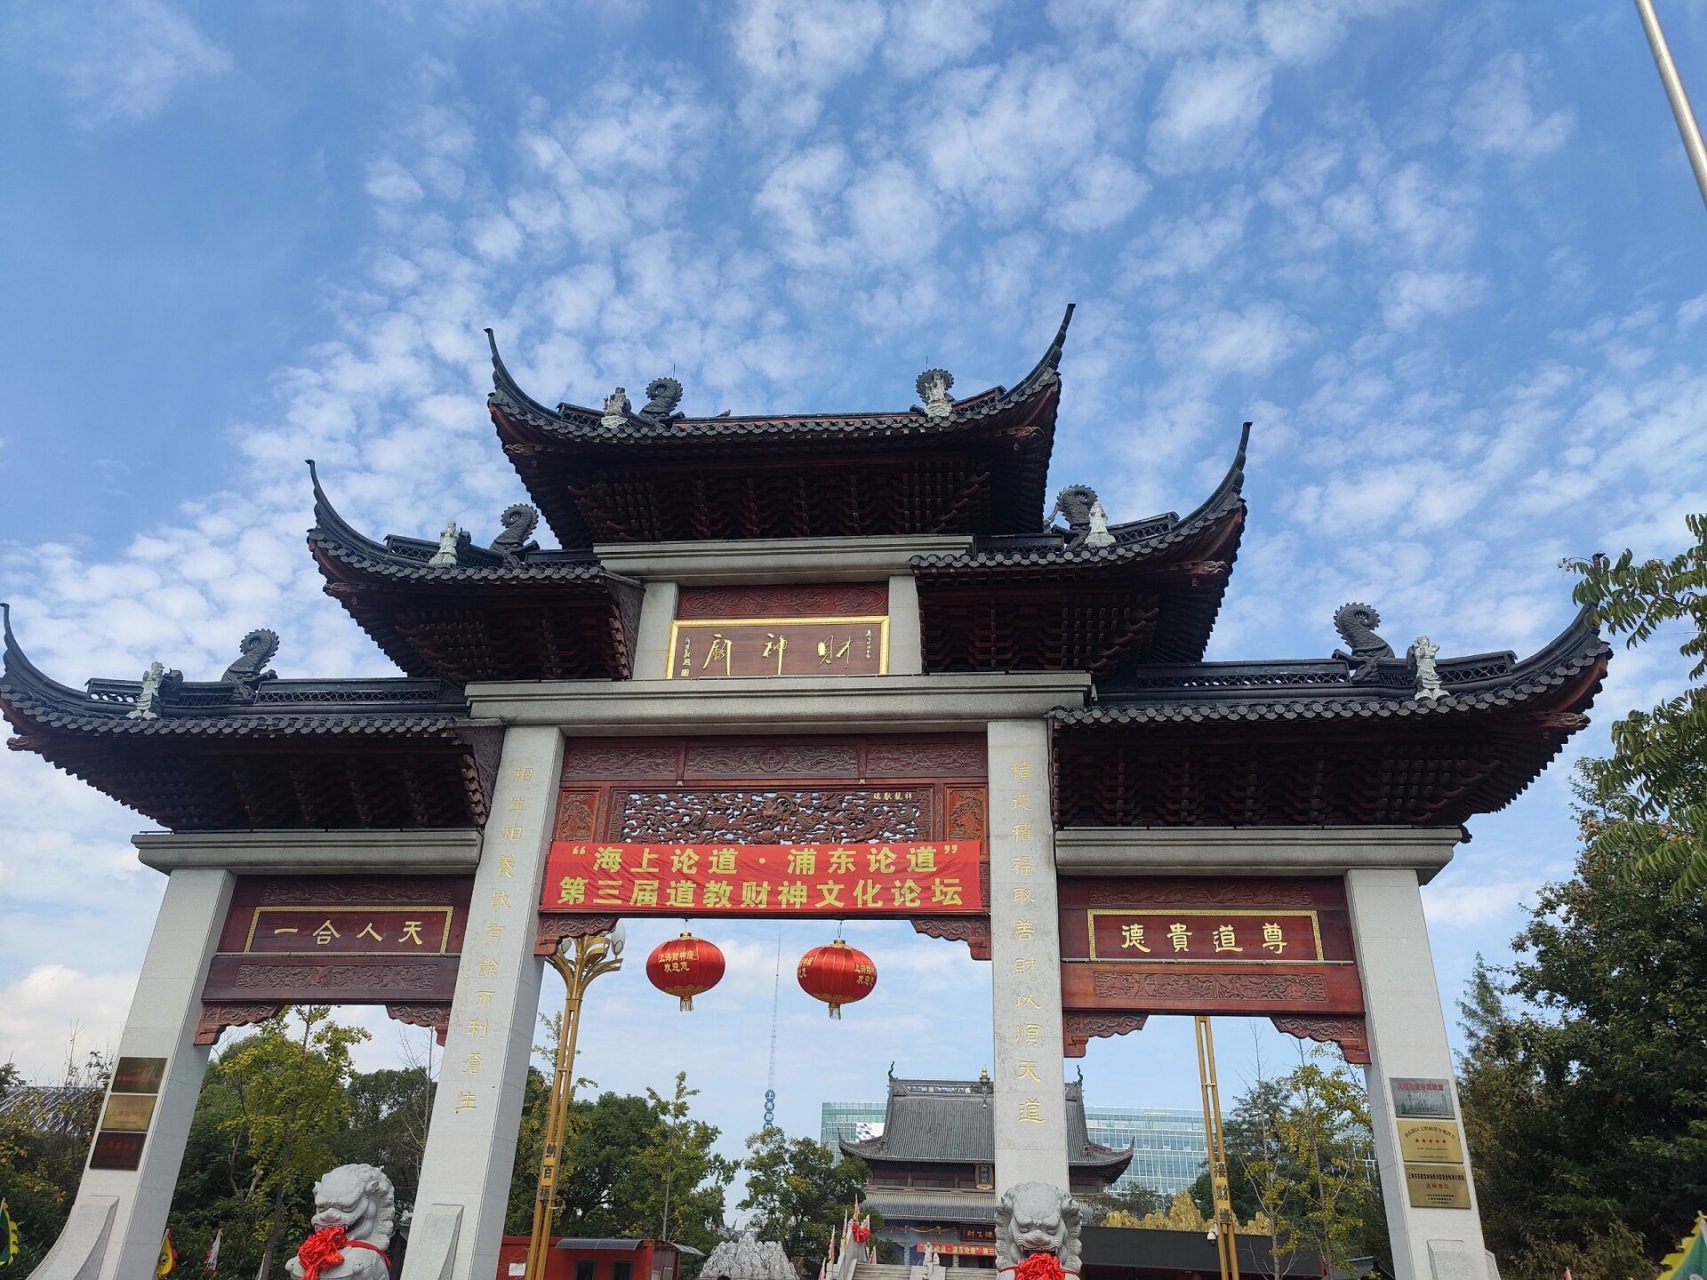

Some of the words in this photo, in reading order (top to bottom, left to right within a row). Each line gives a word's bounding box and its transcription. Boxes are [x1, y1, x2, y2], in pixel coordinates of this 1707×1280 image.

[556, 876, 965, 909] 第三届道教财神文化论坛
[274, 920, 424, 945] 天人合一
